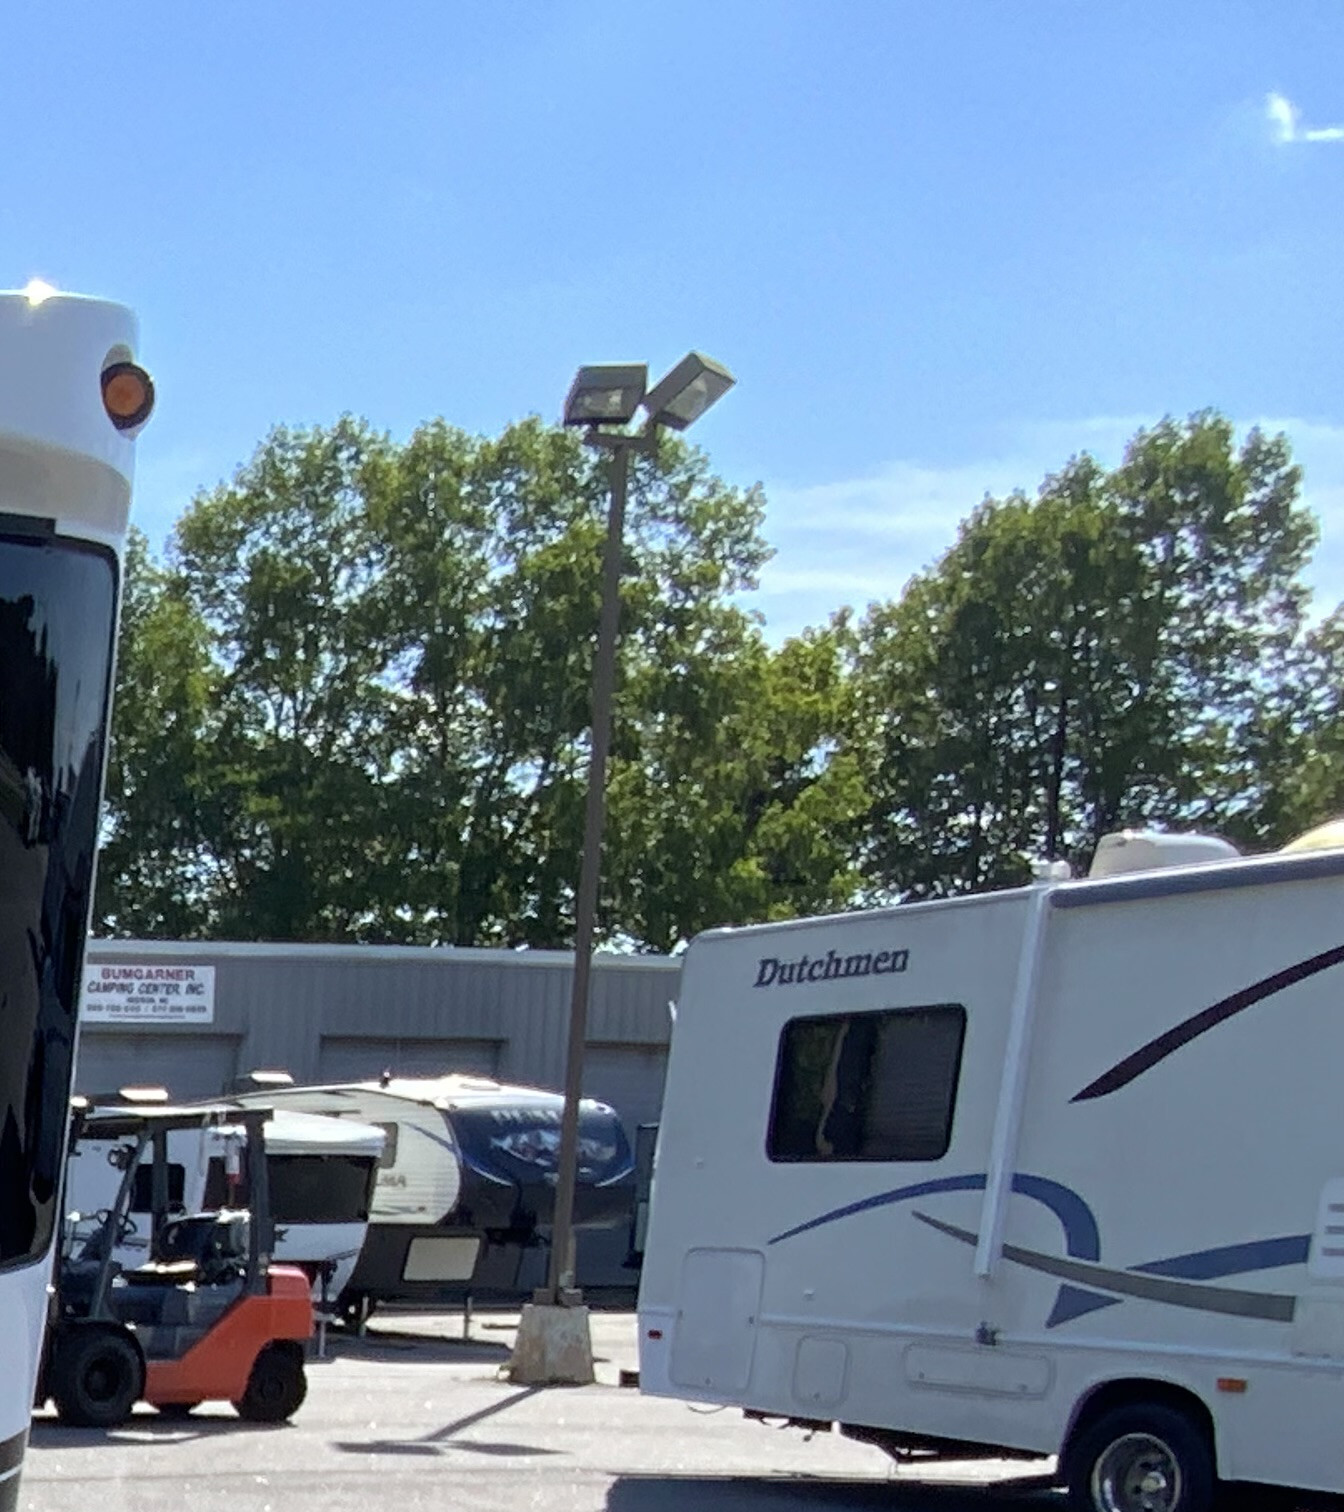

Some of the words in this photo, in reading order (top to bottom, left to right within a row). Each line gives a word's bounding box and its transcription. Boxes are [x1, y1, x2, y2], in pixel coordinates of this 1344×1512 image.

[101, 968, 195, 981] BUMGARNER
[752, 948, 911, 988] Dutchmen
[87, 981, 135, 995] CAMPING
